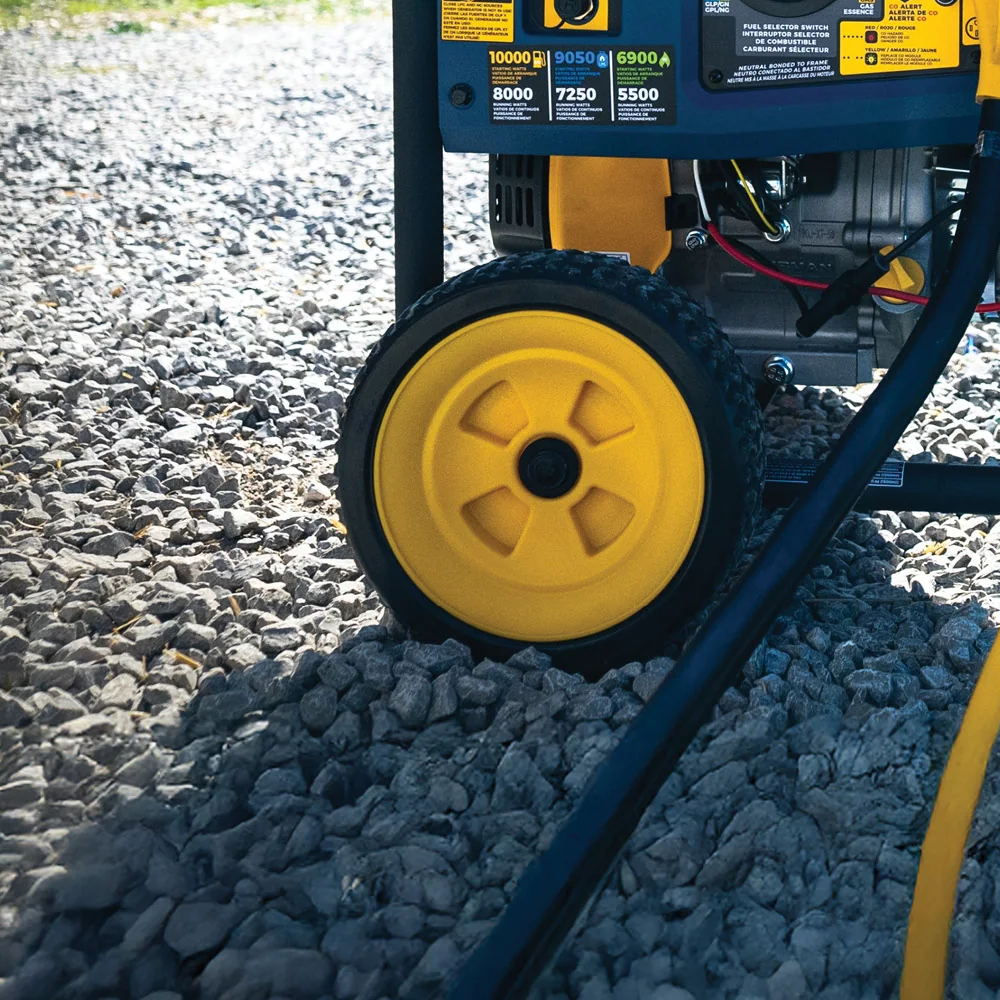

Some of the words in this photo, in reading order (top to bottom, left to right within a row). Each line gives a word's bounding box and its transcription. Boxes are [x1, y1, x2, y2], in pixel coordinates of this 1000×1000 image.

[489, 51, 531, 64] 10000
[555, 51, 595, 64] 9050
[616, 51, 658, 64] 6900
[493, 87, 533, 100] 8000
[556, 87, 597, 100] 7250
[618, 87, 659, 100] 5500
